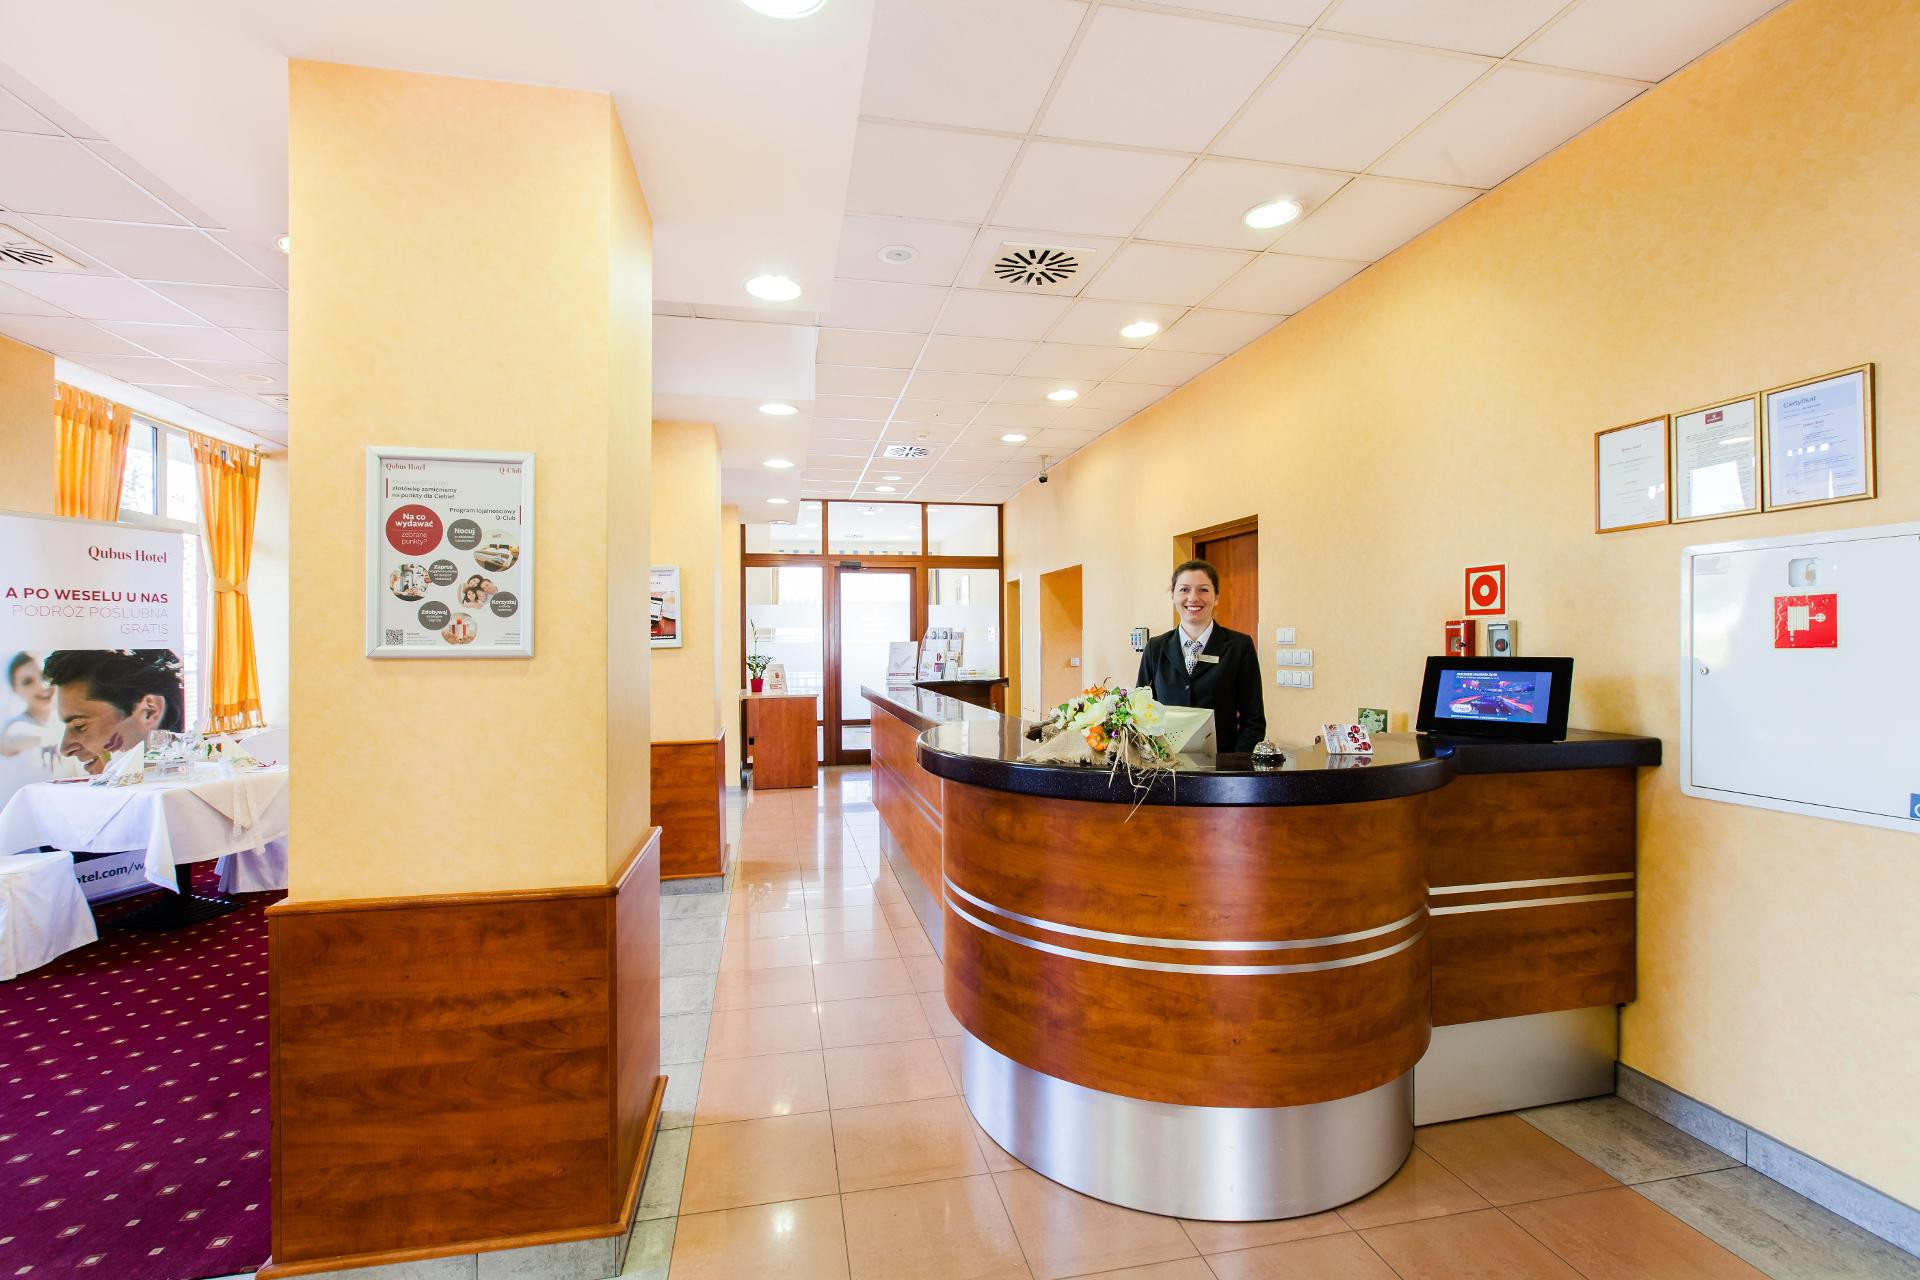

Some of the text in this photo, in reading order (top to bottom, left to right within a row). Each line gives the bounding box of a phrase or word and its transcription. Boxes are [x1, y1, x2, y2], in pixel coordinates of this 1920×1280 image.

[395, 519, 434, 528] wydawać
[454, 527, 476, 536] Nocuj
[401, 538, 428, 546] punkty?
[88, 545, 167, 563] Qubus Hotel
[5, 587, 168, 604] A PO WESELU U NAS
[89, 605, 169, 619] POŚLUBNA
[120, 623, 169, 635] GRATIS
